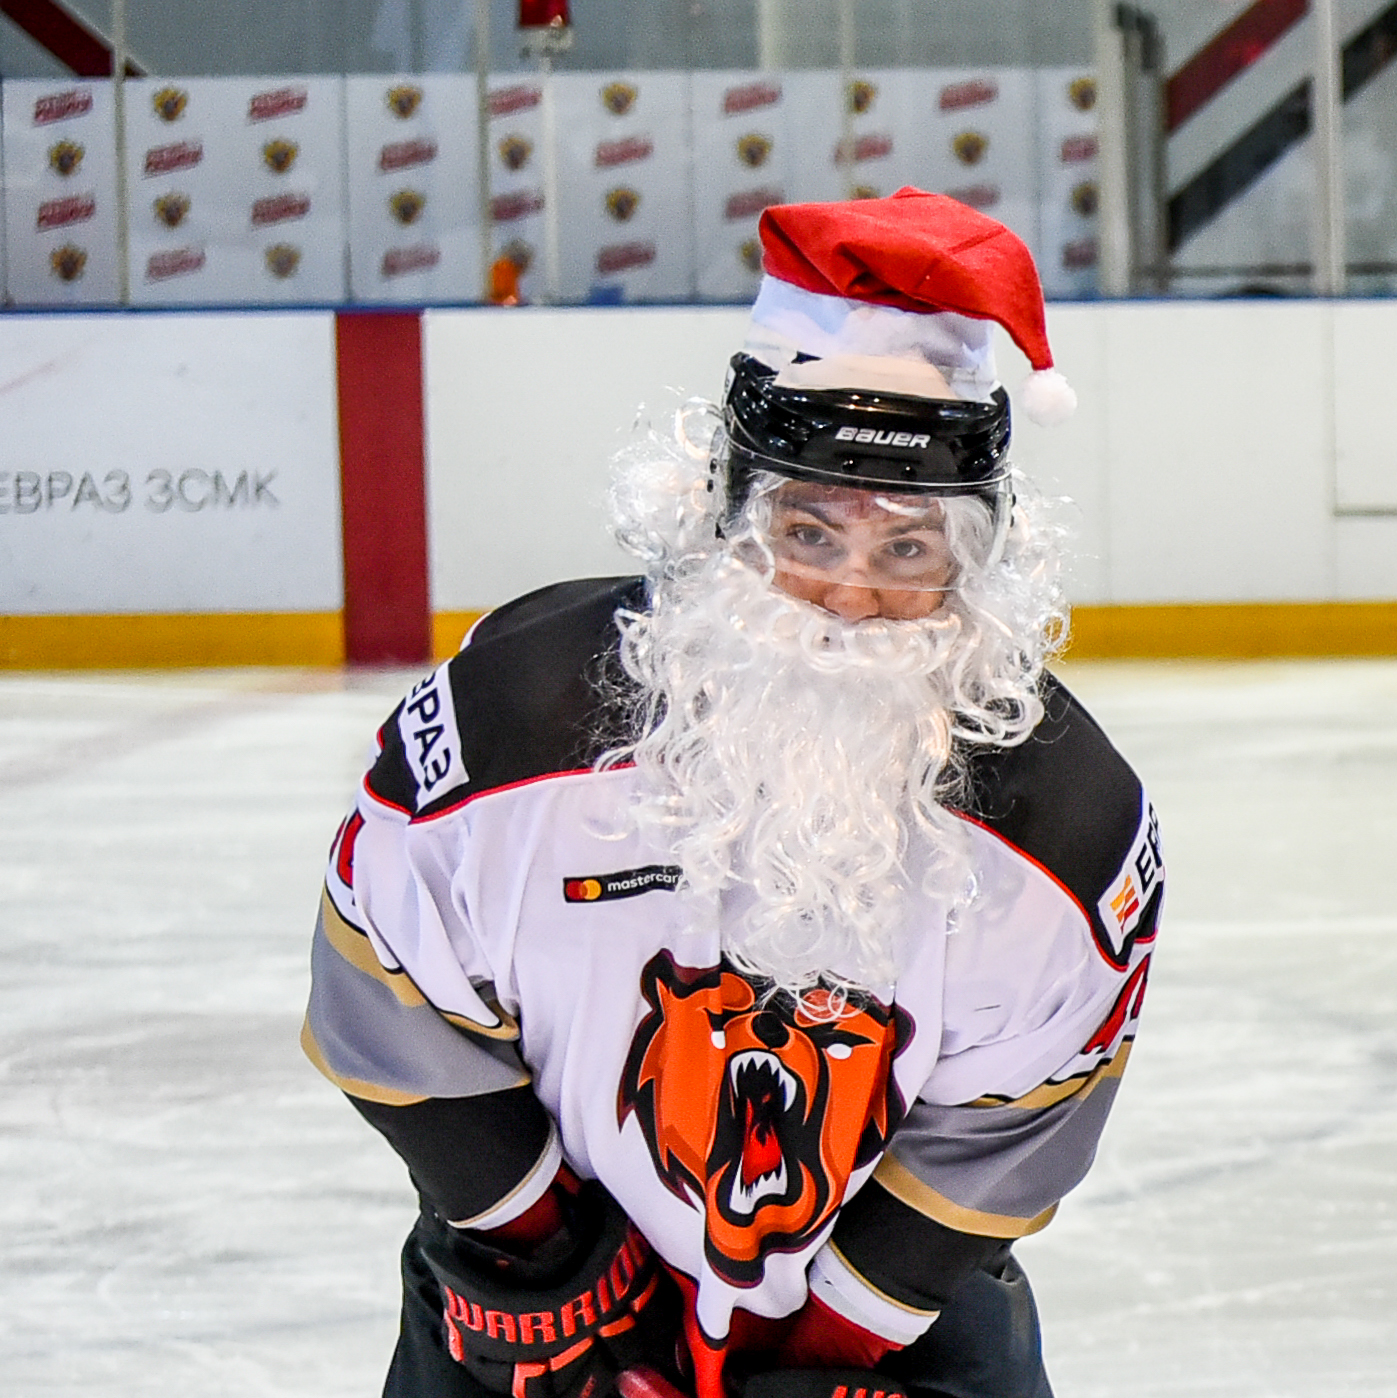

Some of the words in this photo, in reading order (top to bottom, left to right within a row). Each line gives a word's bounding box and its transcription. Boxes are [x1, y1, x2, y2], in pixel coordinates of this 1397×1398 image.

[835, 427, 931, 448] BAUER
[145, 468, 280, 514] ЗСМК
[607, 872, 683, 892] mastercar
